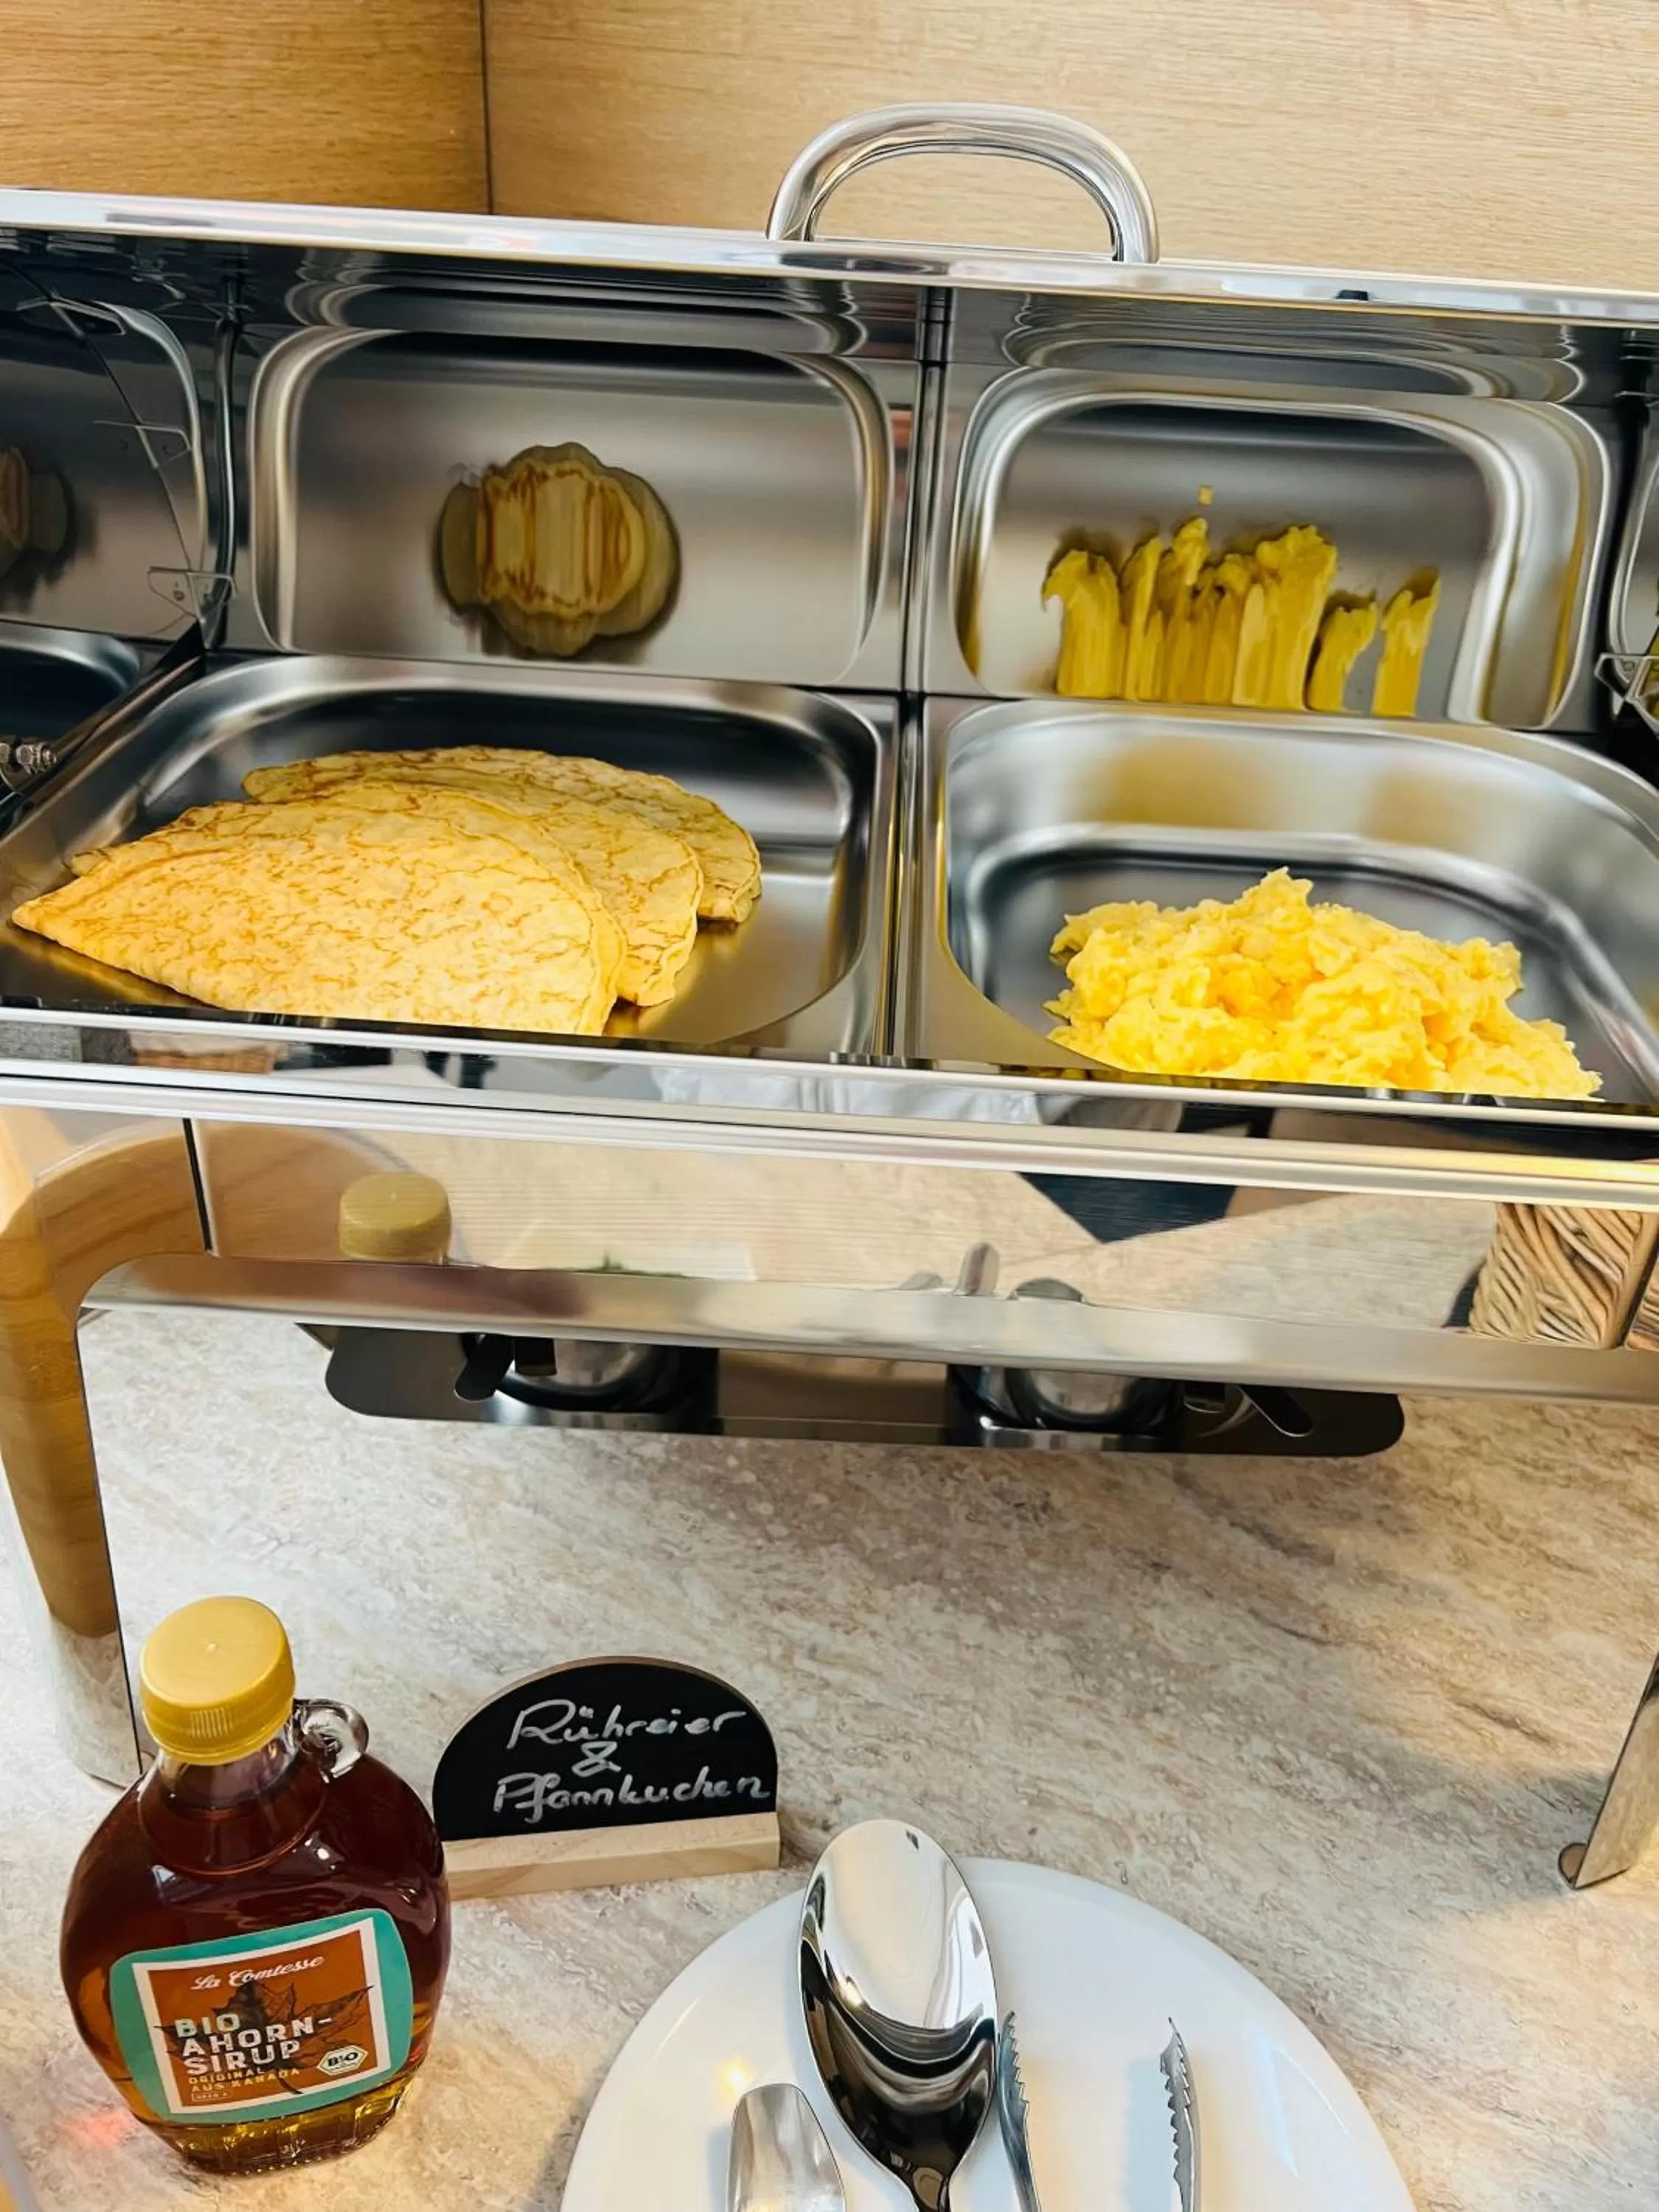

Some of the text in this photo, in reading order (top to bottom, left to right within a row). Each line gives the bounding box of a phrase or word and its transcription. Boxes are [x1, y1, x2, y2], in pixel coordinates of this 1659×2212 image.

[507, 1698, 747, 1750] Rühreier
[571, 1741, 622, 1778] &
[492, 1765, 771, 1824] Pfannkuchen
[229, 1955, 325, 1987] Comtesse
[174, 2012, 240, 2037] BIO
[182, 2016, 332, 2056] AHORN-
[183, 2039, 300, 2076] SIRUP
[327, 2052, 359, 2067] BIO
[188, 2067, 265, 2084] ORIGINAL
[192, 2067, 300, 2093] AUS KANADA
